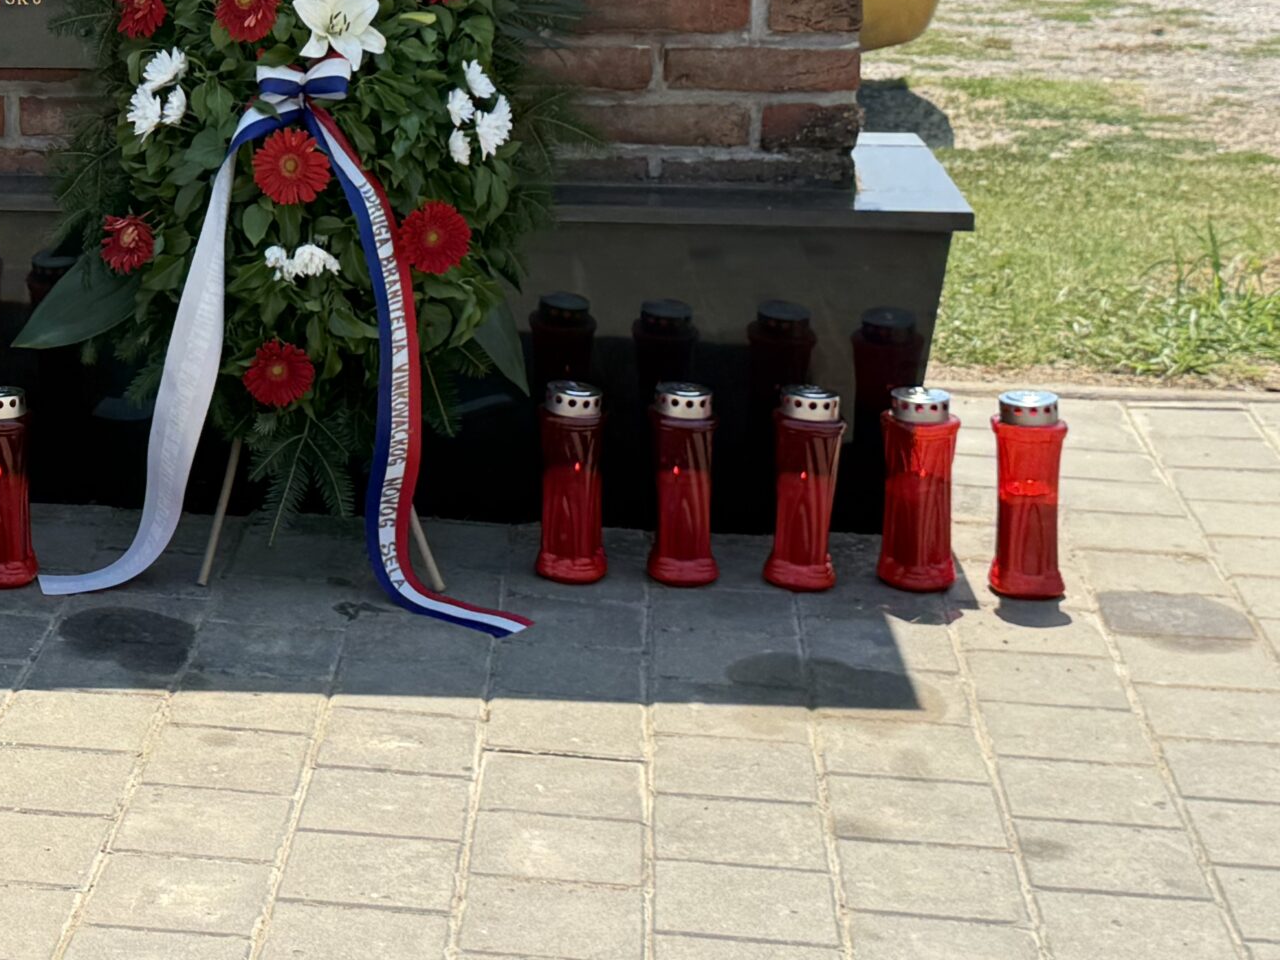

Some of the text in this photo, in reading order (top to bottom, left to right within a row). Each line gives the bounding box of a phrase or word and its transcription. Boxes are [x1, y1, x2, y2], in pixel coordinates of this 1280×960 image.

[379, 254, 408, 356] BRANITELJA
[378, 476, 403, 529] NOVOG
[381, 541, 404, 589] SELA
